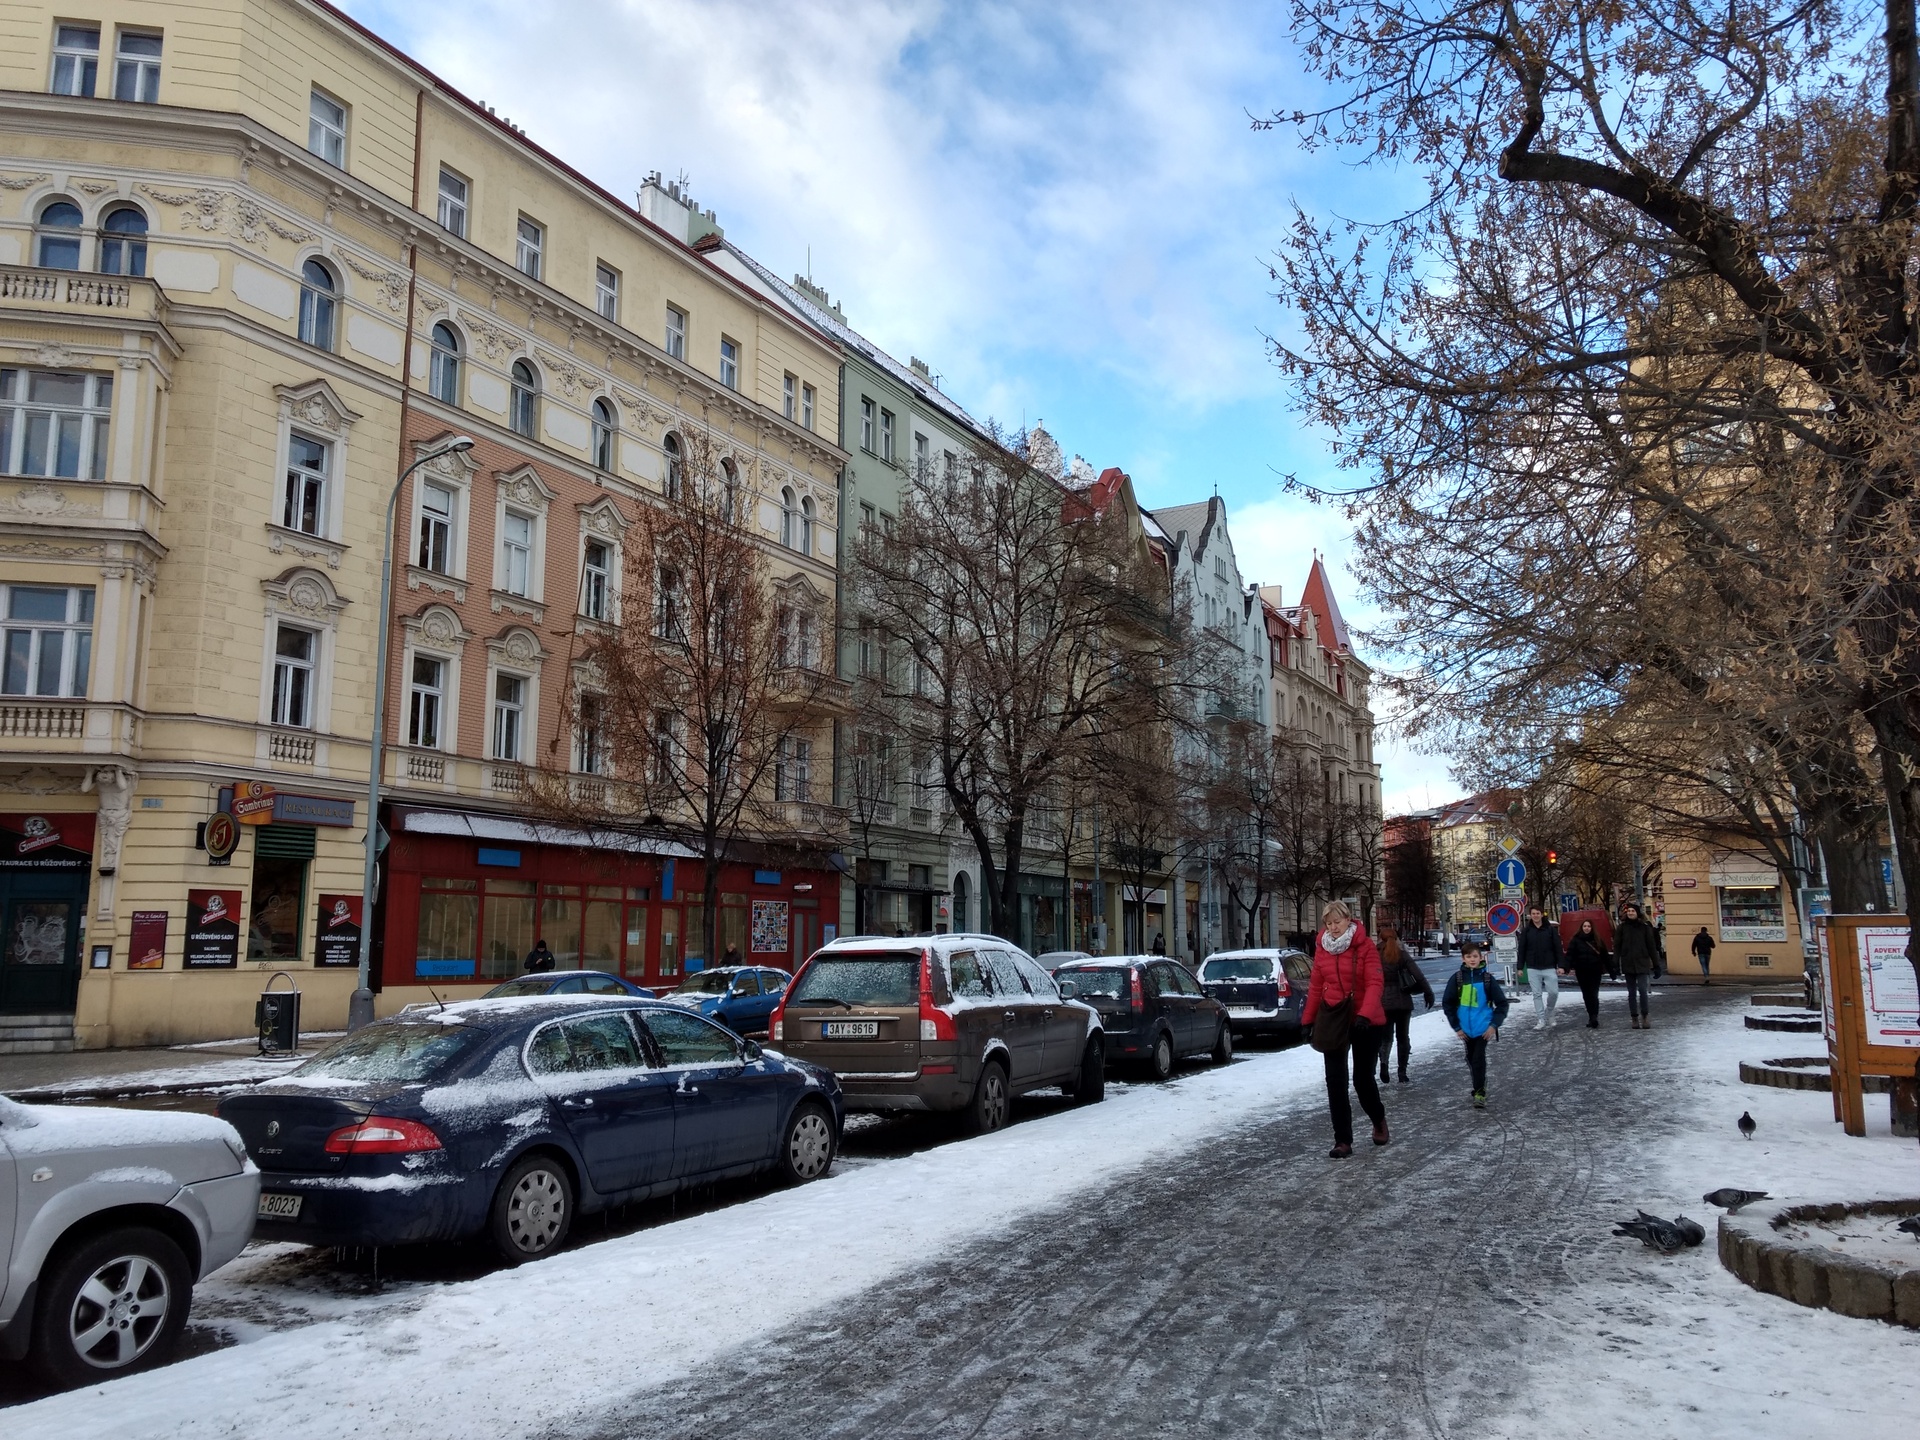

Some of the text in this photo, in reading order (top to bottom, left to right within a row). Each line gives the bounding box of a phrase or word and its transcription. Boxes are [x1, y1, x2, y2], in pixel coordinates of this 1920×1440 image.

[236, 797, 274, 814] Gambrinus
[285, 803, 351, 818] RESTAURACE
[18, 833, 60, 853] Gambrinus
[1721, 874, 1762, 883] Potraviny
[829, 1023, 874, 1034] 3AY 9616
[258, 1146, 283, 1155] Superb
[267, 1196, 296, 1215] 8023
